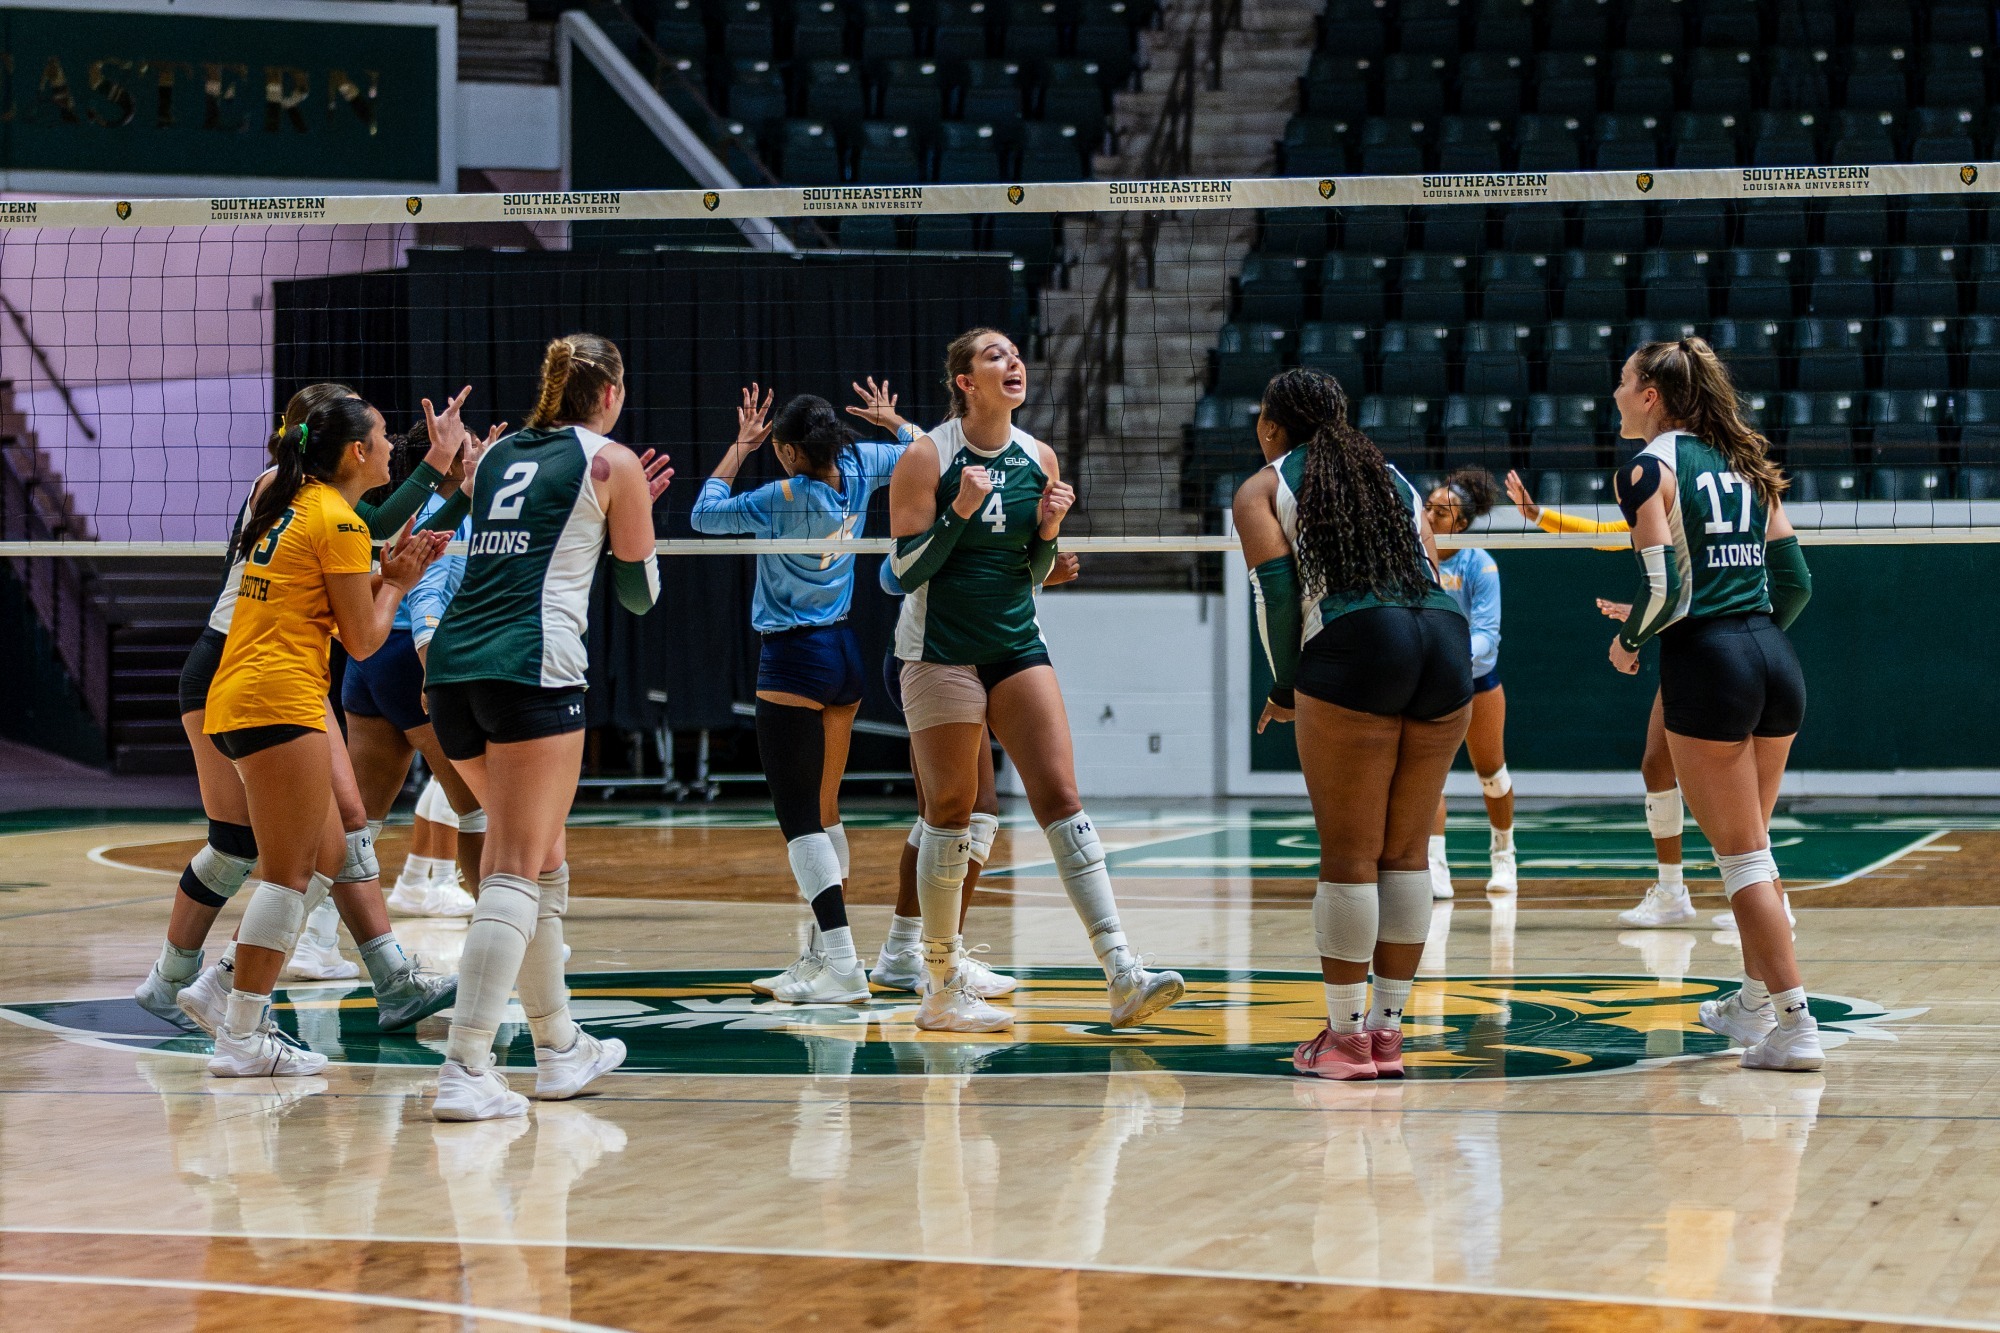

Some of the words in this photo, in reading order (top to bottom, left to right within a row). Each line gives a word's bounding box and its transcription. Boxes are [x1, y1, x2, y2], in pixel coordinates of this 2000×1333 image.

[1743, 167, 1870, 181] SOUTHEASTERN
[1109, 181, 1232, 194] SOUTHEASTERN
[1422, 174, 1548, 188] SOUTHEASTERN
[1743, 183, 1801, 191] LOUISIANA
[1805, 181, 1870, 190] UNIVERSITY
[503, 192, 621, 205] SOUTHEASTERN
[802, 187, 923, 200] SOUTHEASTERN
[1110, 196, 1166, 204] LOUISIANA
[1169, 194, 1232, 203] UNIVERSITY
[1423, 189, 1480, 198] LOUISIANA
[1484, 188, 1548, 197] UNIVERSITY
[211, 198, 326, 211] SOUTHEASTERN
[503, 207, 557, 215] LOUISIANA
[560, 206, 621, 214] UNIVERSITY
[803, 202, 858, 210] LOUISIANA
[861, 201, 923, 209] UNIVERSITY
[211, 212, 263, 220] LOUISIANA
[266, 210, 326, 219] UNIVERSITY
[487, 461, 539, 521] 2
[1695, 471, 1752, 535] 17
[981, 492, 1007, 533] 4
[469, 530, 532, 557] LIONS
[1706, 543, 1762, 568] LIONS
